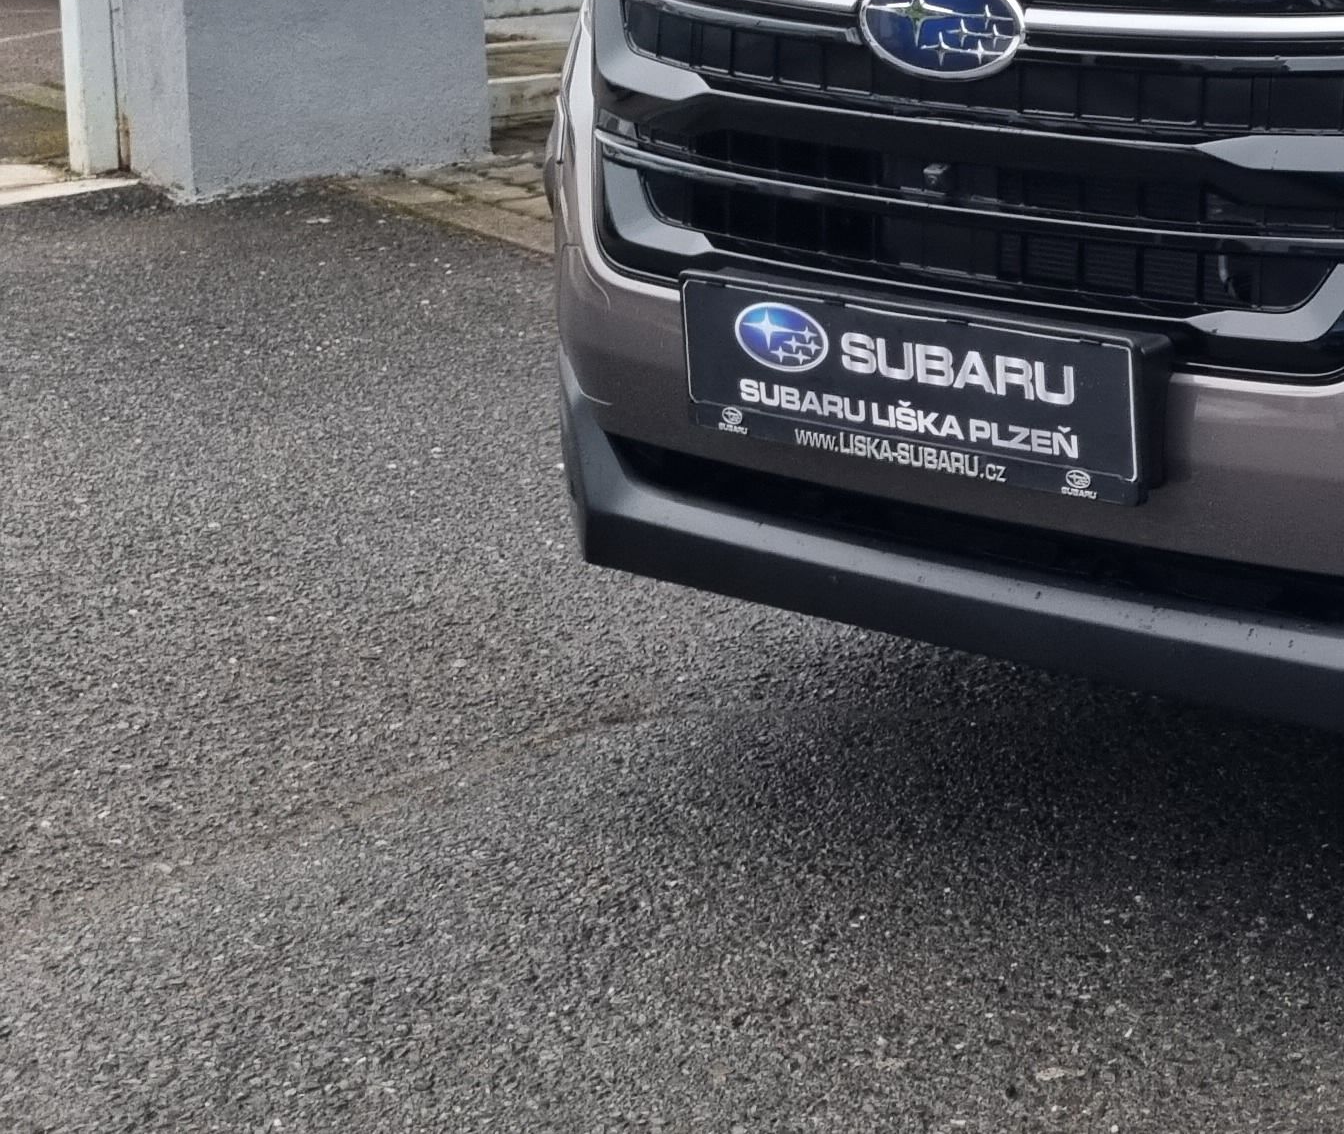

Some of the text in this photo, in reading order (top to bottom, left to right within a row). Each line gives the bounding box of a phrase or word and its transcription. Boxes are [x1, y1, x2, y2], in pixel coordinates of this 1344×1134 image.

[841, 331, 1074, 406] SUBARU
[718, 422, 748, 435] SUBARU
[739, 378, 1078, 459] SUBARU LIŠKA PLZEŇ
[795, 428, 1007, 483] www.LISKA-SUBARU.cz
[1061, 486, 1097, 499] SUBARU
